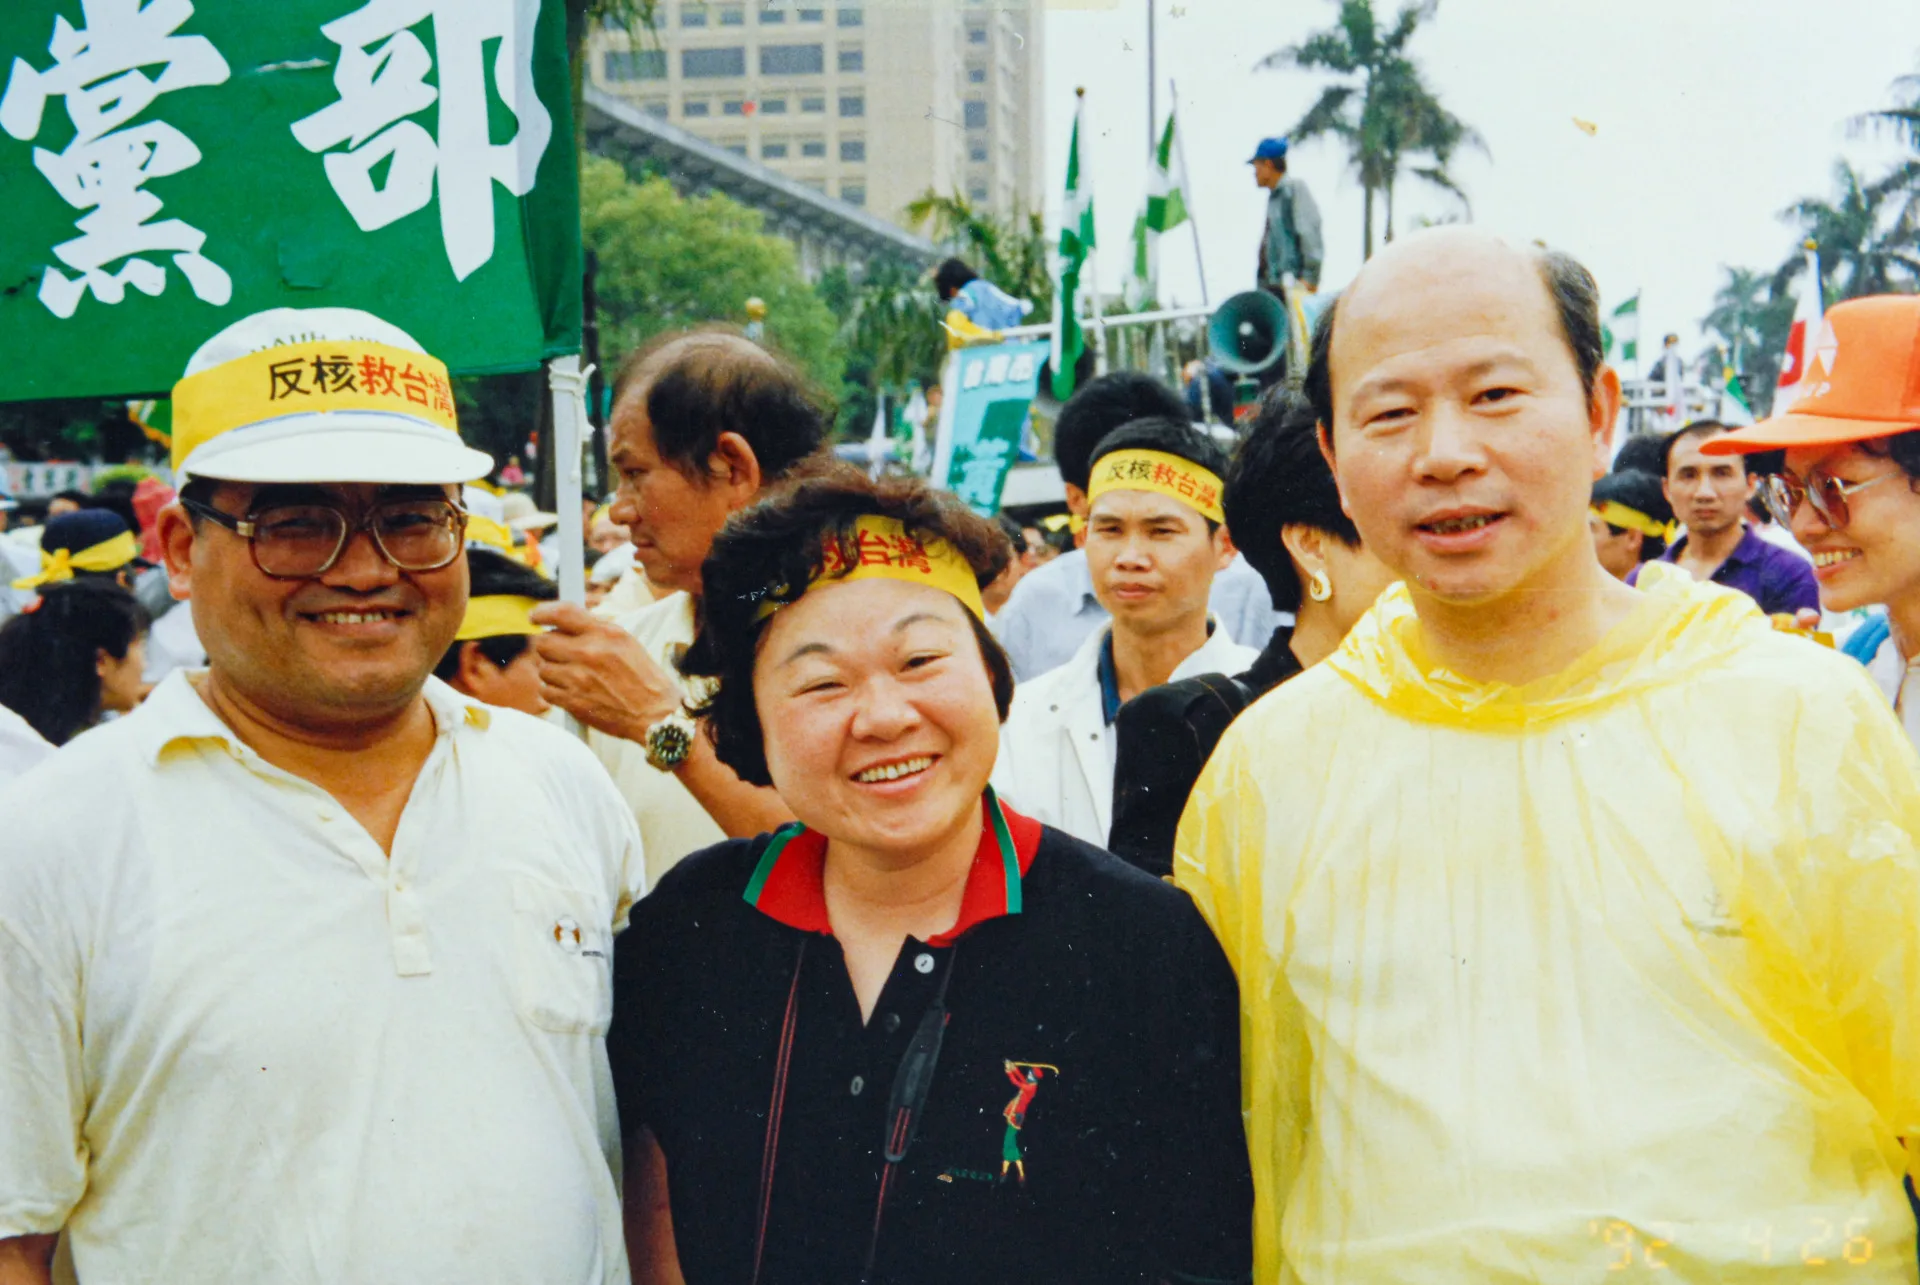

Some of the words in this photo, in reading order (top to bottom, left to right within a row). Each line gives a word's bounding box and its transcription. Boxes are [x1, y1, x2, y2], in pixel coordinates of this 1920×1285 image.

[0, 0, 552, 319] 黨部
[268, 354, 454, 418] 反核救台灣
[1105, 459, 1217, 509] 反核救台灣
